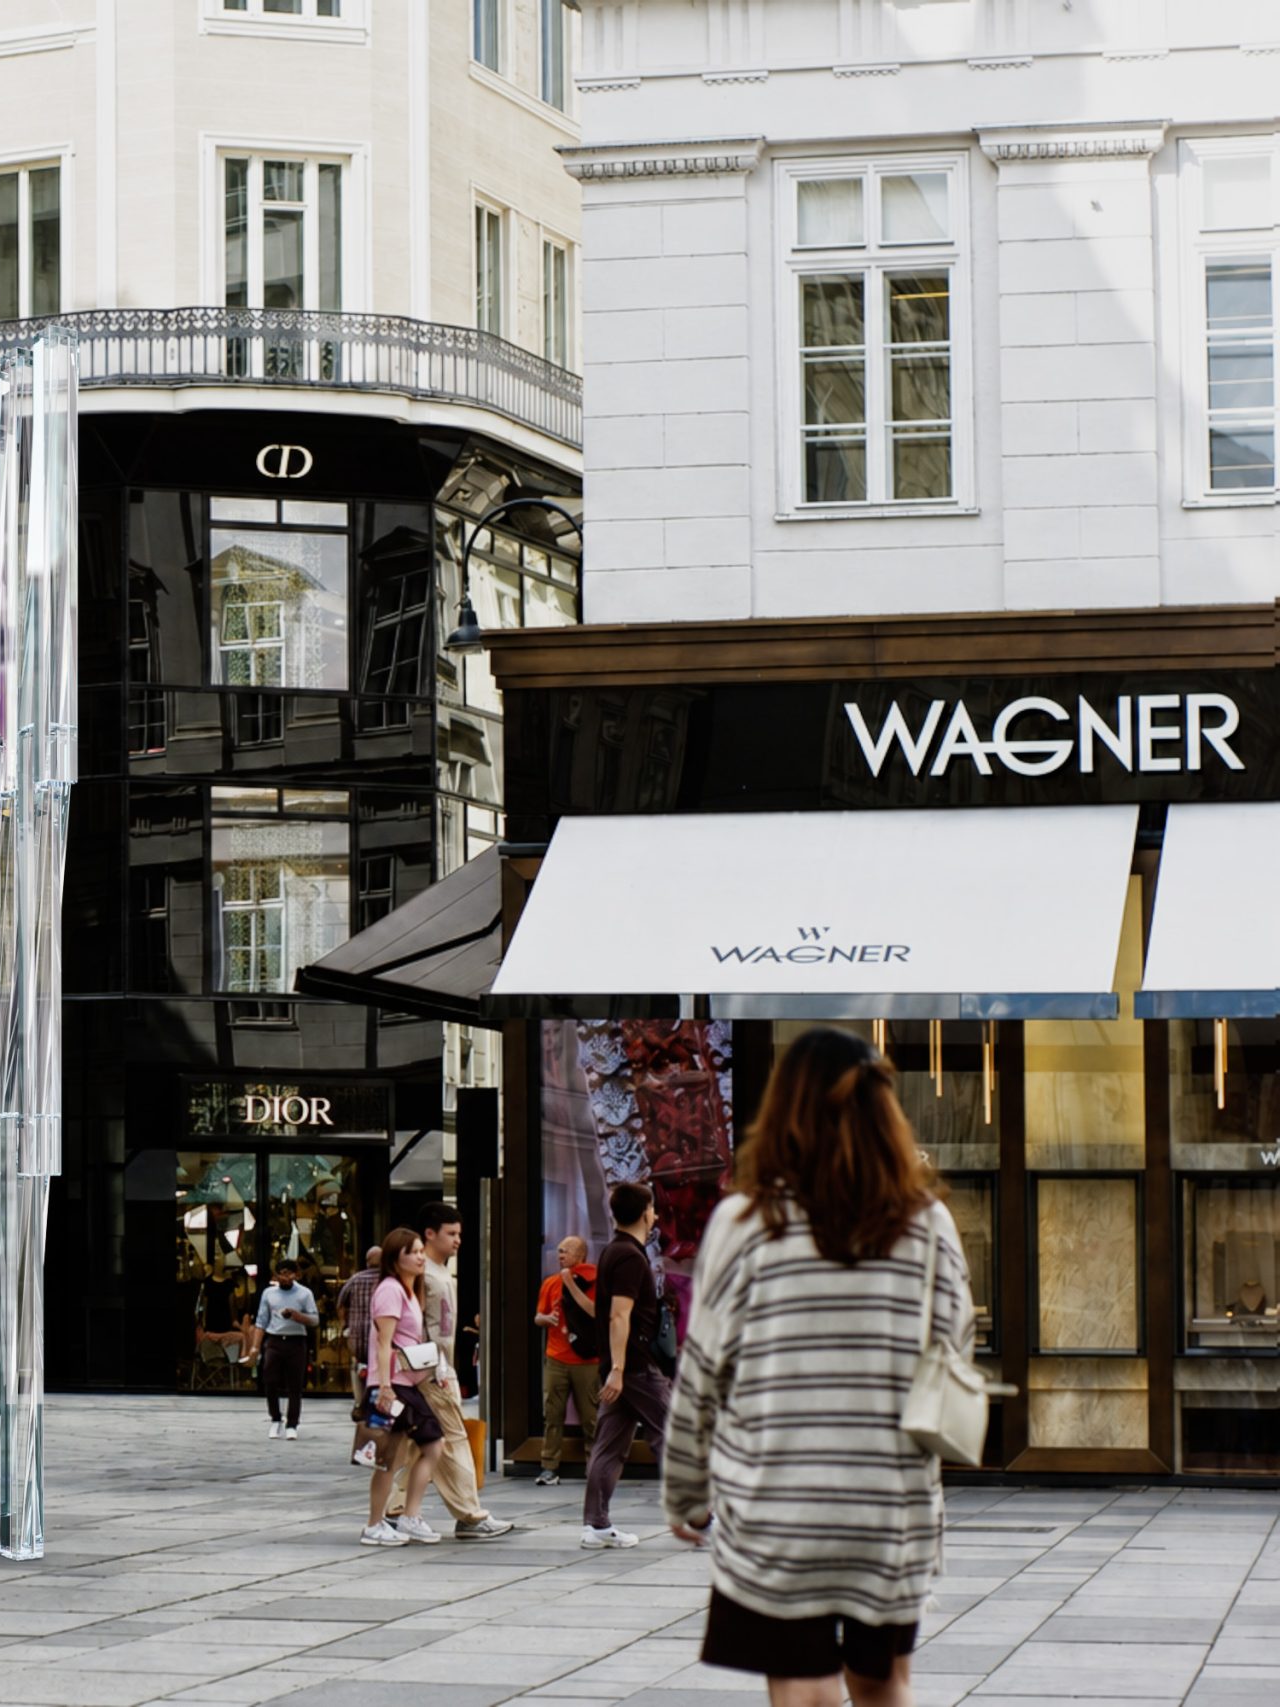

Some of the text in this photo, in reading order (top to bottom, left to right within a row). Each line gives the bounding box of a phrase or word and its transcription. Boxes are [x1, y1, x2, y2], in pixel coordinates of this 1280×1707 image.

[844, 692, 1246, 778] WAGNER
[711, 944, 911, 964] WAGNER
[244, 1094, 334, 1126] DIOR
